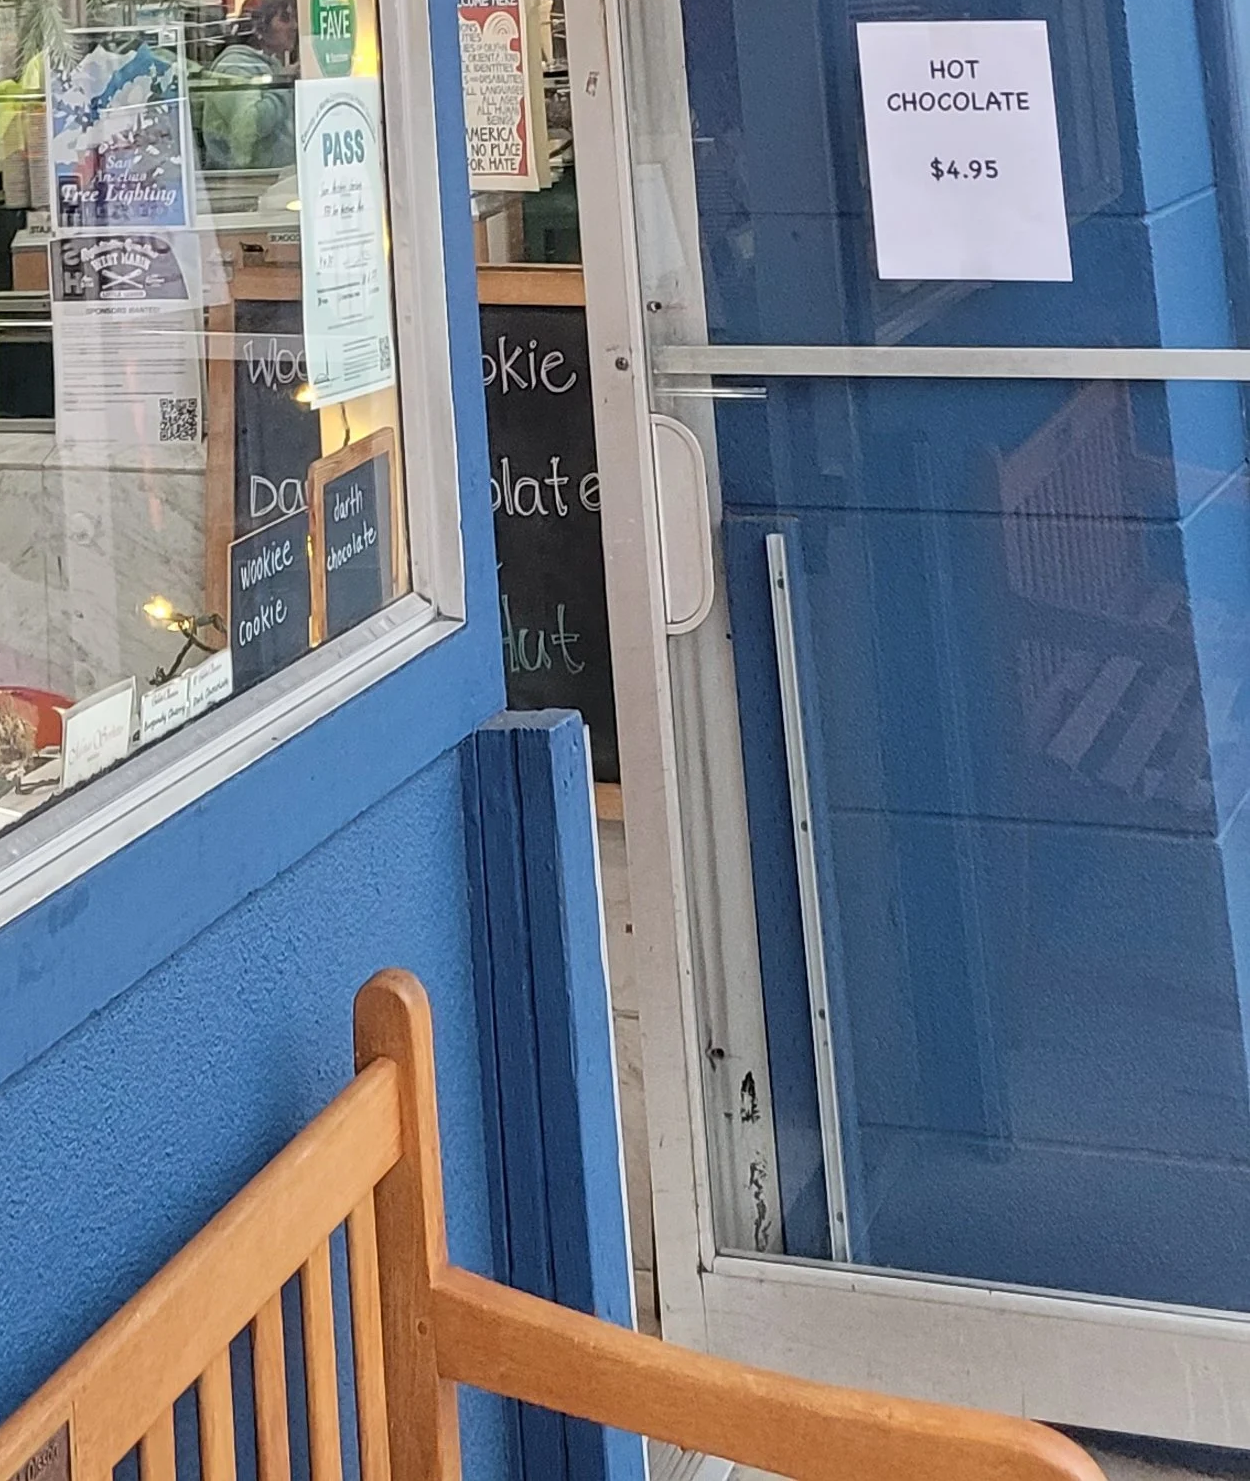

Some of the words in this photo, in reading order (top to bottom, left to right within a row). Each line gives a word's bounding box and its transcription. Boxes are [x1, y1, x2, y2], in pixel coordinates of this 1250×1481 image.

[319, 9, 351, 41] FAVE
[929, 59, 980, 81] HOT
[886, 90, 1031, 113] CHOCOLATE
[322, 130, 365, 167] PASS
[471, 143, 487, 157] NO
[491, 143, 521, 157] PLACE
[489, 157, 517, 171] HATE
[929, 156, 1000, 184] $4.95
[105, 184, 177, 207] Lighting
[333, 483, 364, 523] darth
[327, 520, 377, 572] chocolate
